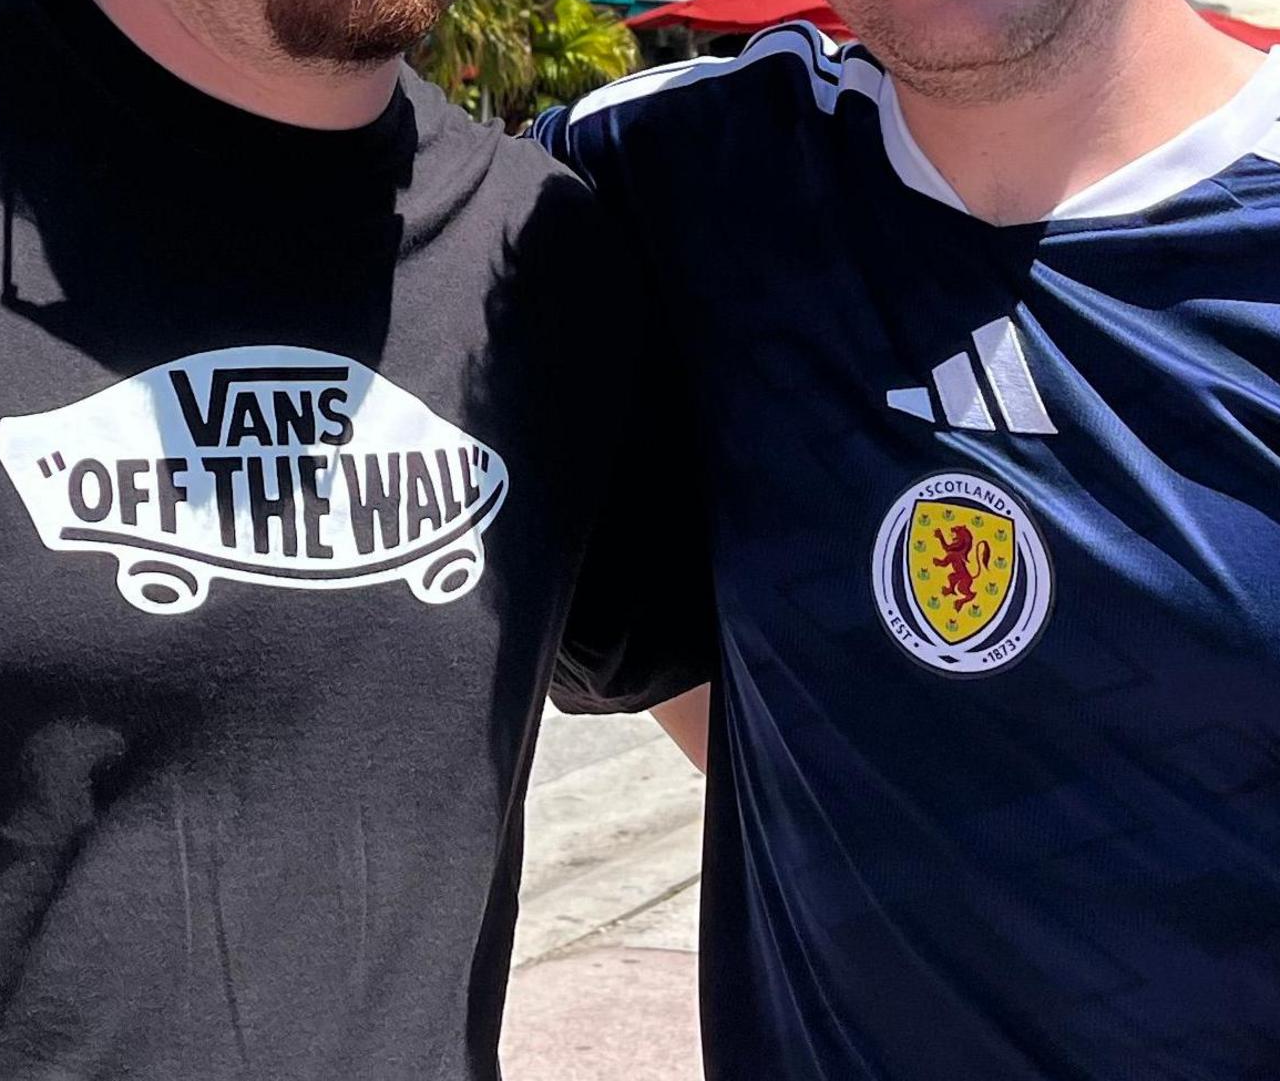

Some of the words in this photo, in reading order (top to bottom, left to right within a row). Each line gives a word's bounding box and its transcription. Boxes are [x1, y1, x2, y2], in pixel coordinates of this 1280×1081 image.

[36, 450, 189, 535] "OFF
[201, 455, 334, 559] THE
[339, 444, 490, 555] WALL"
[925, 480, 1006, 512] SCOTLAND
[889, 615, 914, 642] EST
[987, 638, 1017, 663] 1873
